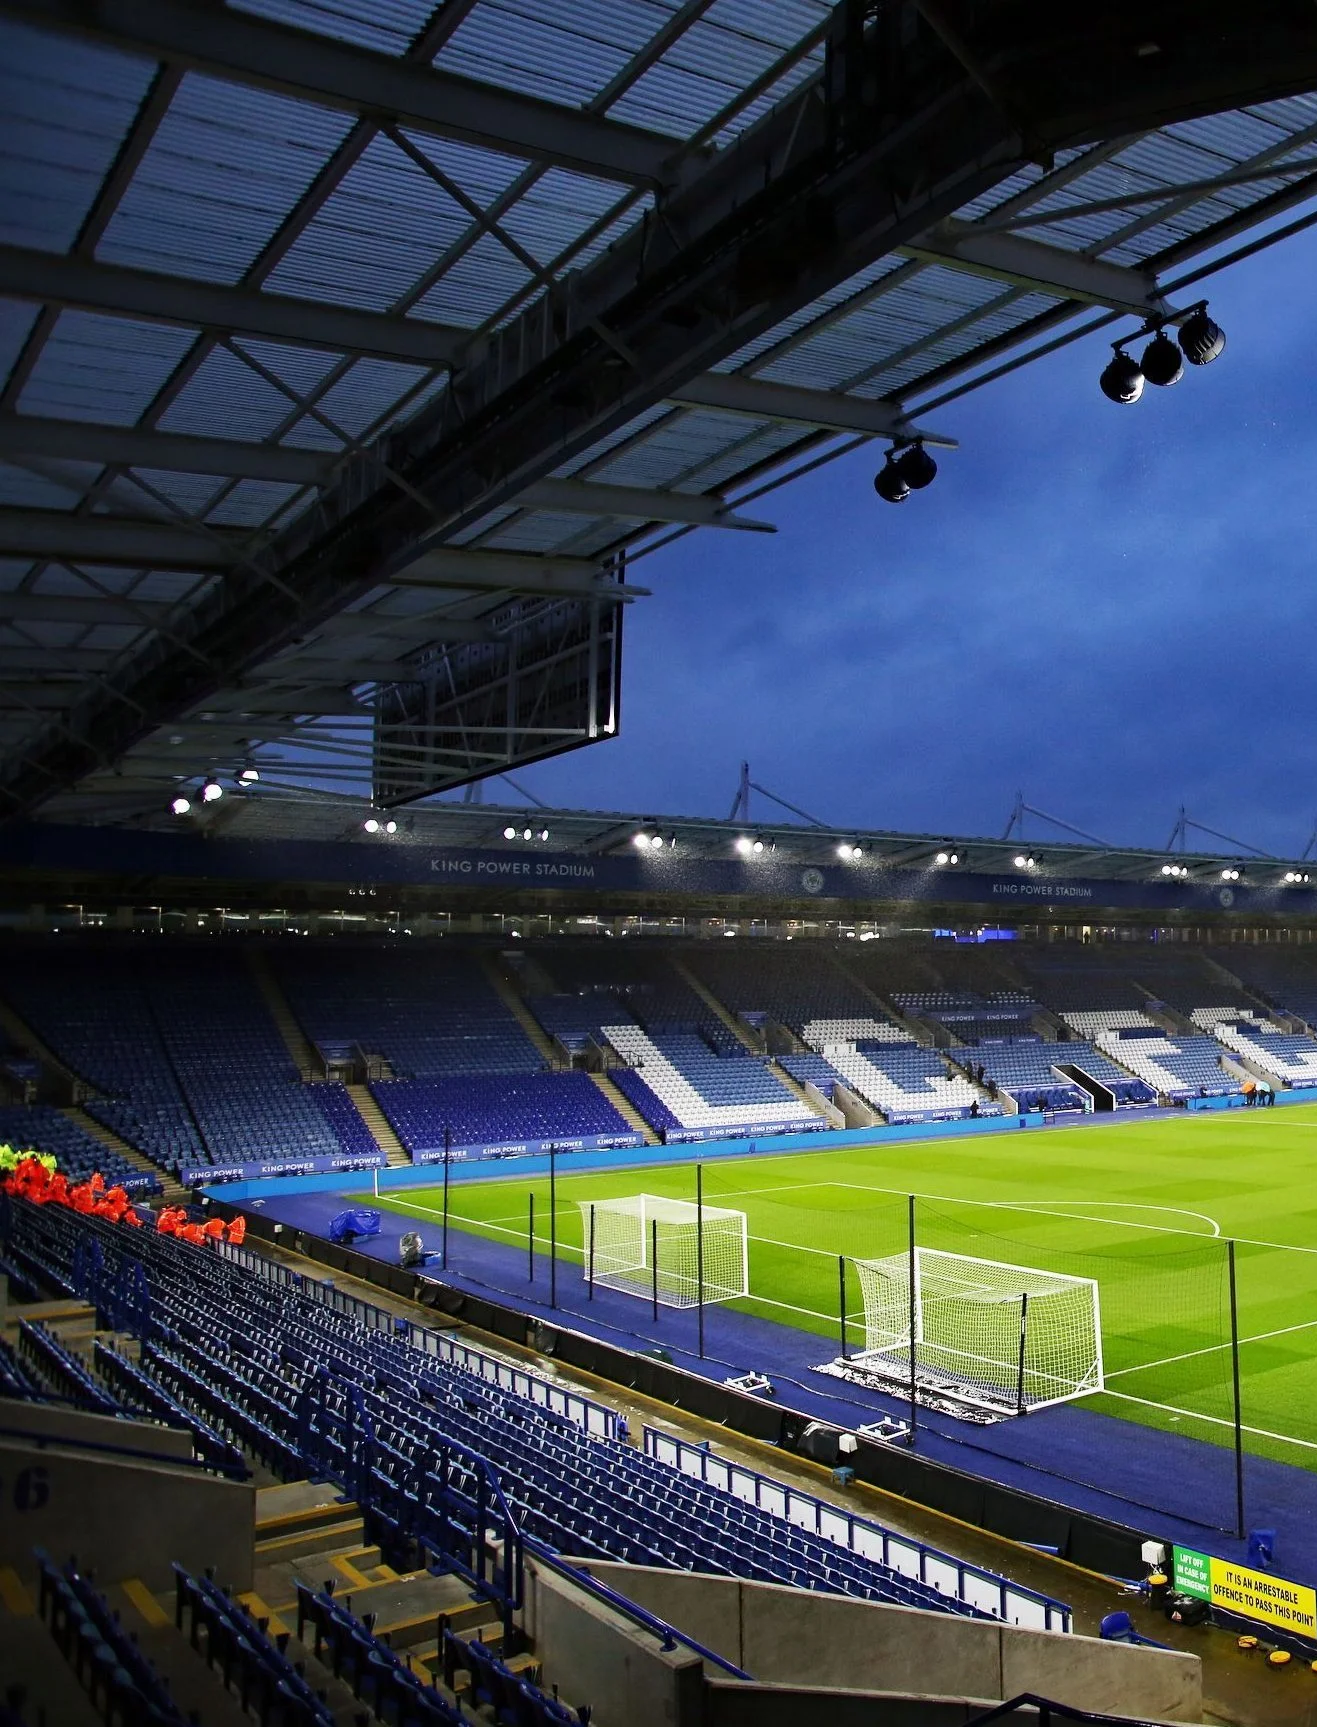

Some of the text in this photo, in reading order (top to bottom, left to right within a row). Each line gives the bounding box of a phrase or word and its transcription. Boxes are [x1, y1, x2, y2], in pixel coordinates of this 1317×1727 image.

[431, 860, 595, 877] KING POWER STADIUM
[993, 884, 1092, 897] KING POWER STADIUM
[560, 1140, 583, 1148] POWER
[614, 1136, 637, 1144] POWER
[502, 1145, 527, 1153] POWER
[262, 1162, 314, 1173] KING POWER
[331, 1157, 381, 1167] KING POWER
[189, 1168, 244, 1180] KING POWER
[1180, 1553, 1204, 1569] LIFT OFF
[1177, 1563, 1208, 1582] IN CASE OF
[1176, 1575, 1210, 1594] EMERGENCY
[1226, 1571, 1298, 1605] IT IS AN ARRESTABLE
[1213, 1583, 1314, 1627] OFFENCE TO PASS THIS POINT
